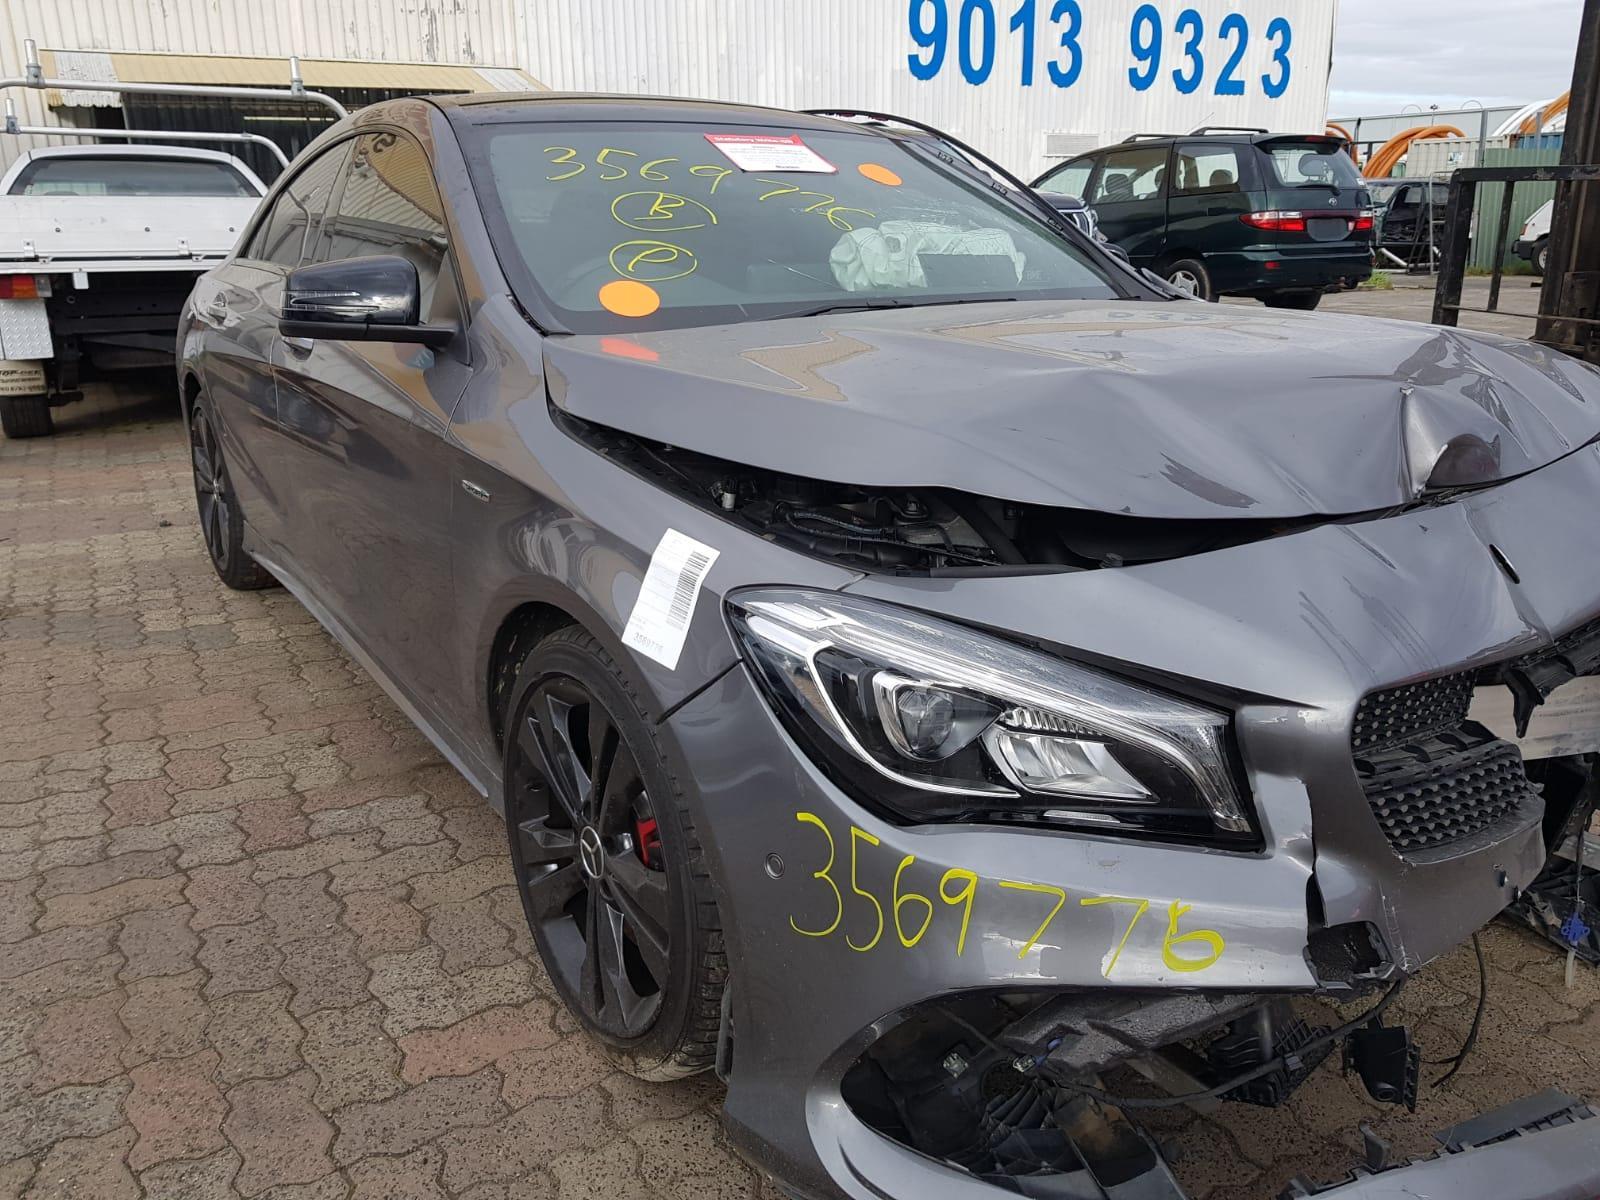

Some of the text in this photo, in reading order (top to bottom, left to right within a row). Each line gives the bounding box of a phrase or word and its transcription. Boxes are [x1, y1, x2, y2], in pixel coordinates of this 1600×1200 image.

[908, 0, 1292, 99] 9013 9323
[789, 812, 1226, 978] 3569776
